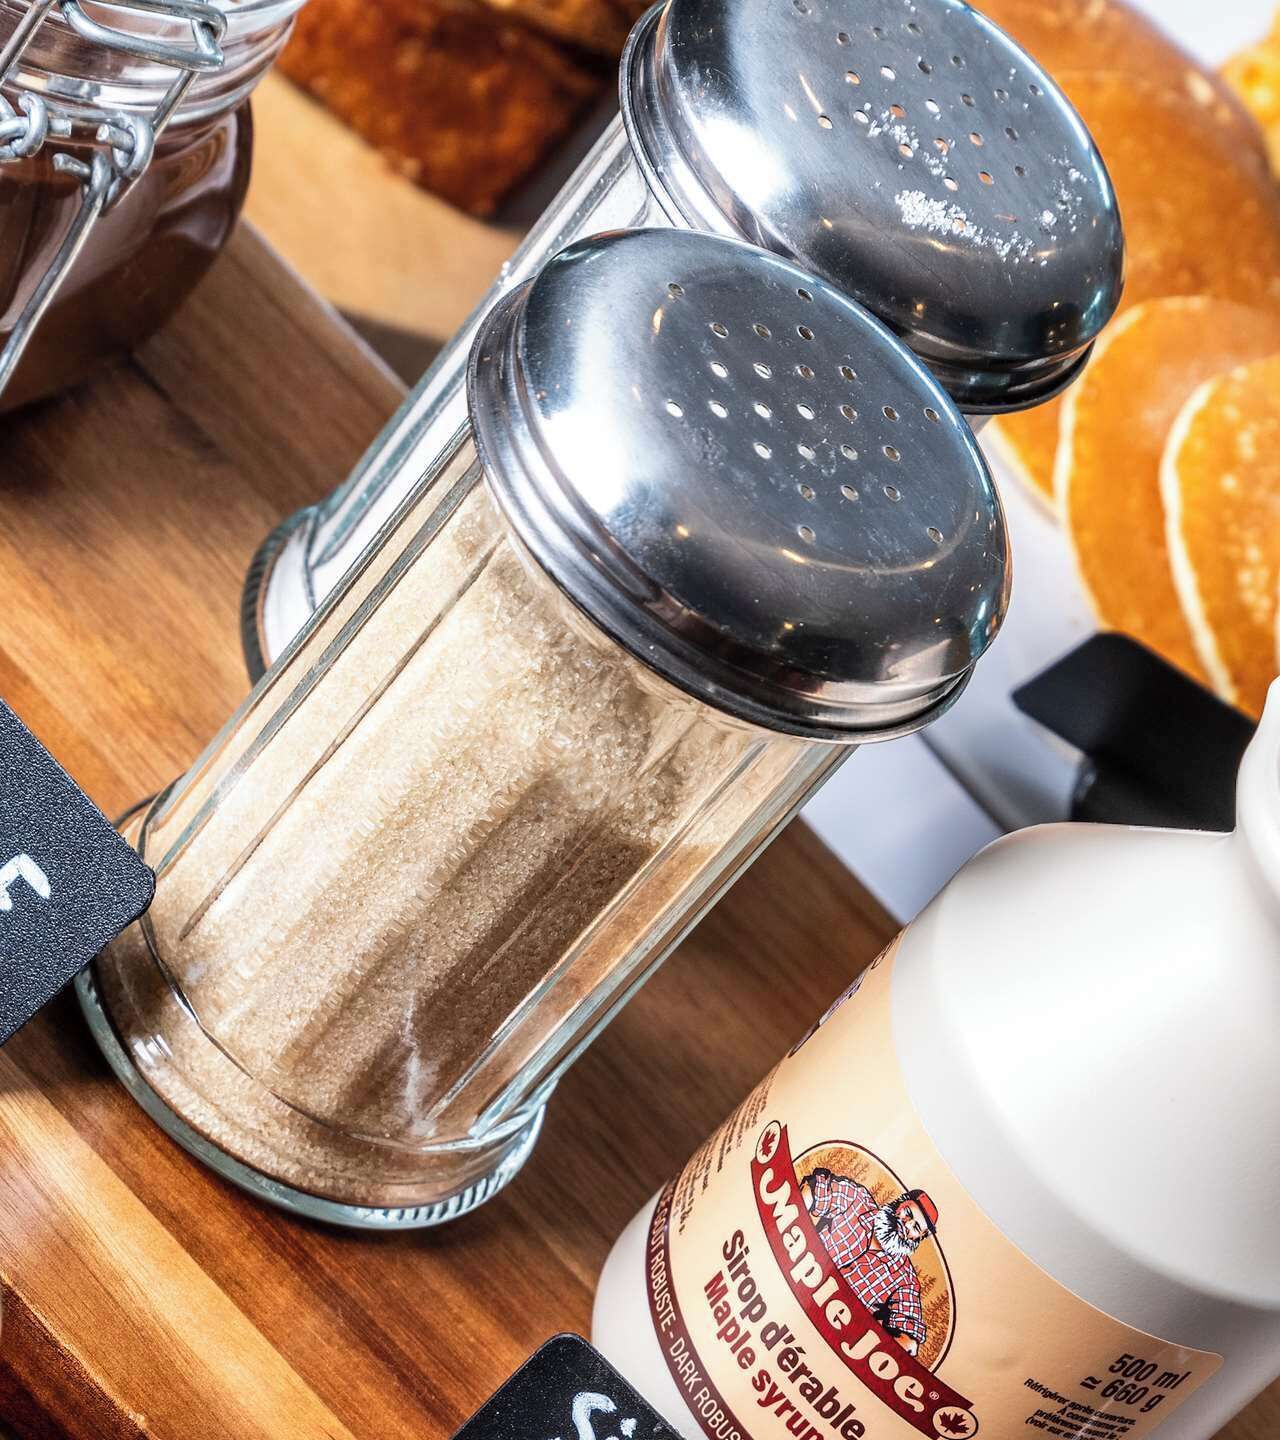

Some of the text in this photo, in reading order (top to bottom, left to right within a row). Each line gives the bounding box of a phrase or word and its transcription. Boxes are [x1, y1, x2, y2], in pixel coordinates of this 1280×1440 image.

[722, 1229, 768, 1324] Sirop
[759, 1167, 925, 1413] Maple Joe
[703, 1270, 756, 1370] Maple
[670, 1337, 703, 1393] DARK
[1108, 1352, 1193, 1390] 500 ml
[1023, 1378, 1071, 1406] Réfrigérer
[1069, 1398, 1096, 1416] après
[1099, 1379, 1150, 1406] 660
[1139, 1394, 1167, 1413] g
[1025, 1416, 1047, 1431] (voir
[1046, 1423, 1064, 1436] sur
